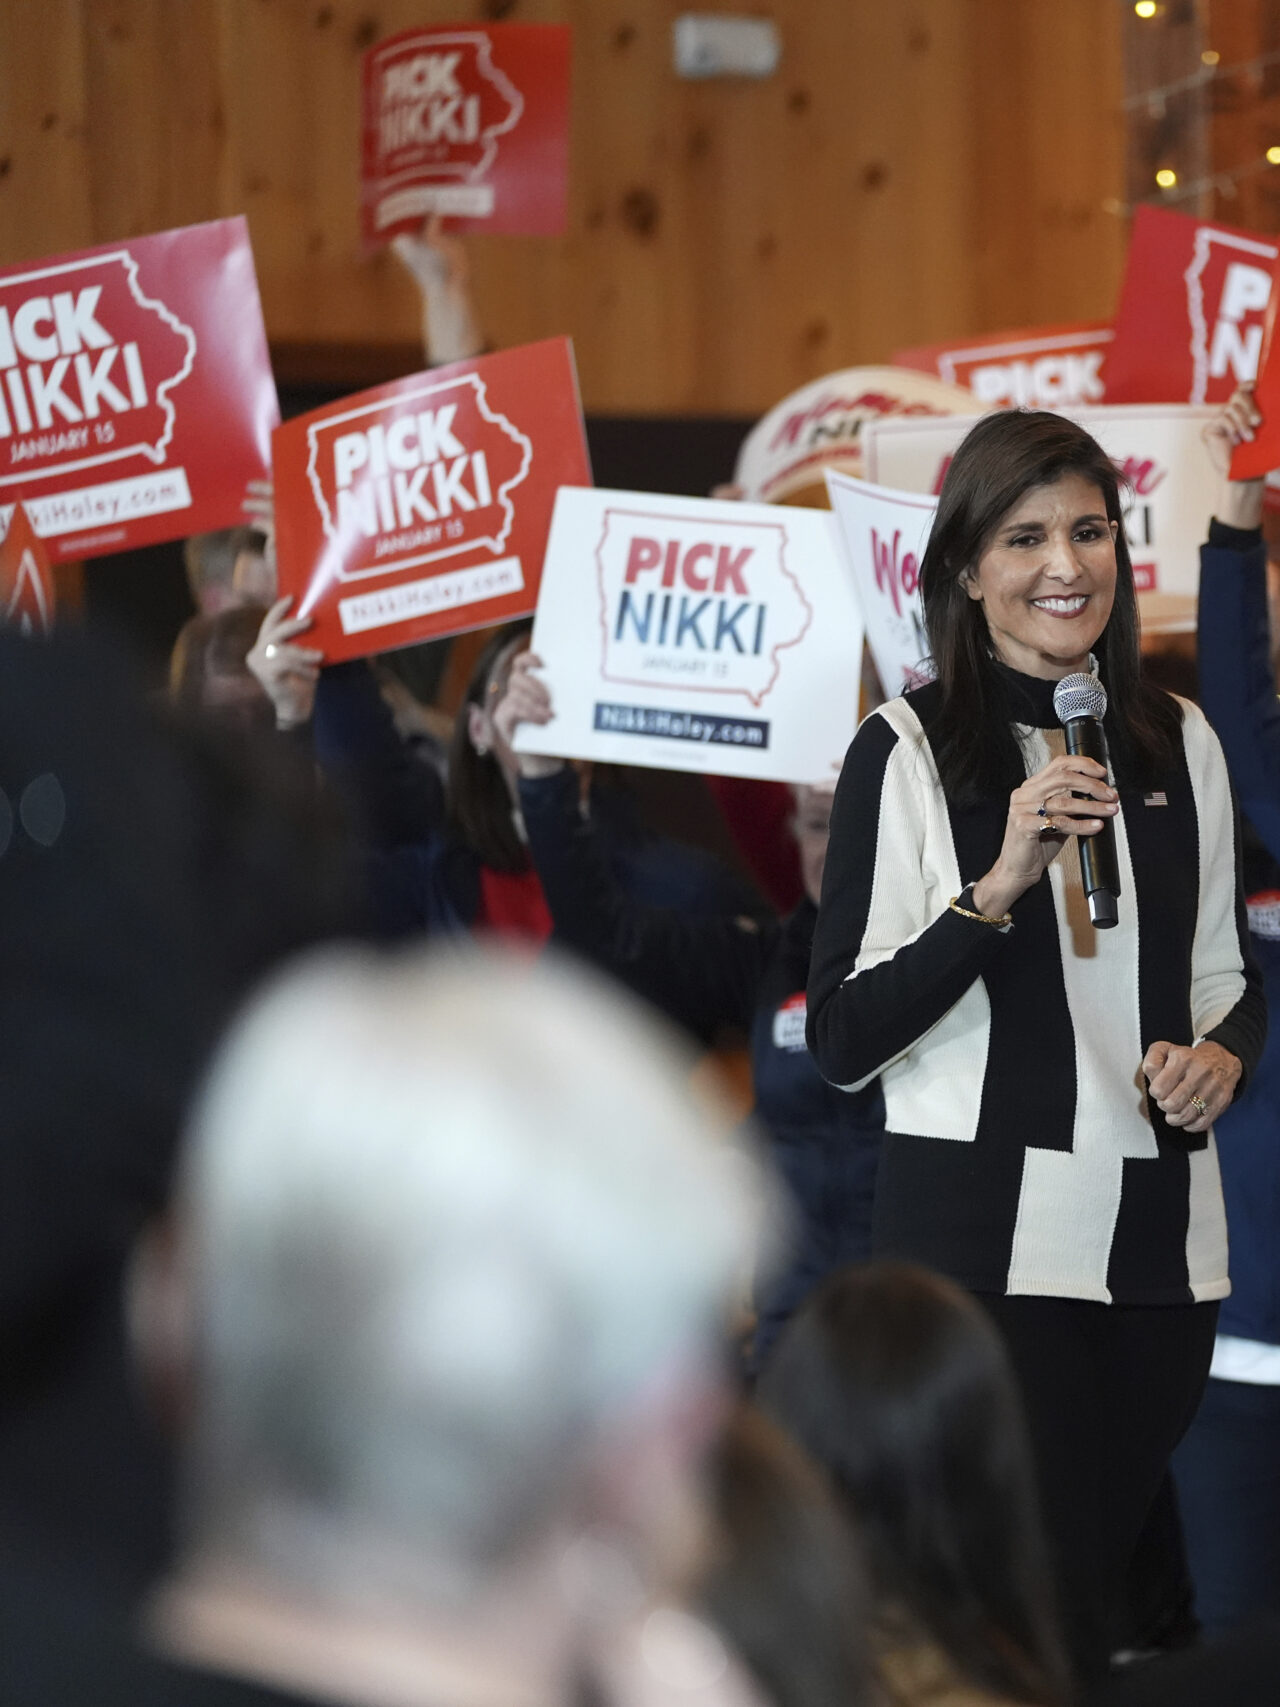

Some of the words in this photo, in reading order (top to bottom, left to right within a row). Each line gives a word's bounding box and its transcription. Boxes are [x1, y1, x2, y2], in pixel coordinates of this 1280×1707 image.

[0, 285, 114, 370] ICK
[969, 350, 1106, 405] PICK
[10, 426, 90, 465] JANUARY
[95, 420, 116, 445] 15
[334, 403, 466, 489] PICK
[336, 449, 493, 538] NIKKI
[625, 536, 756, 596] PICK
[614, 590, 768, 657] NIKKI
[602, 707, 764, 745] NikkiHaley.com
